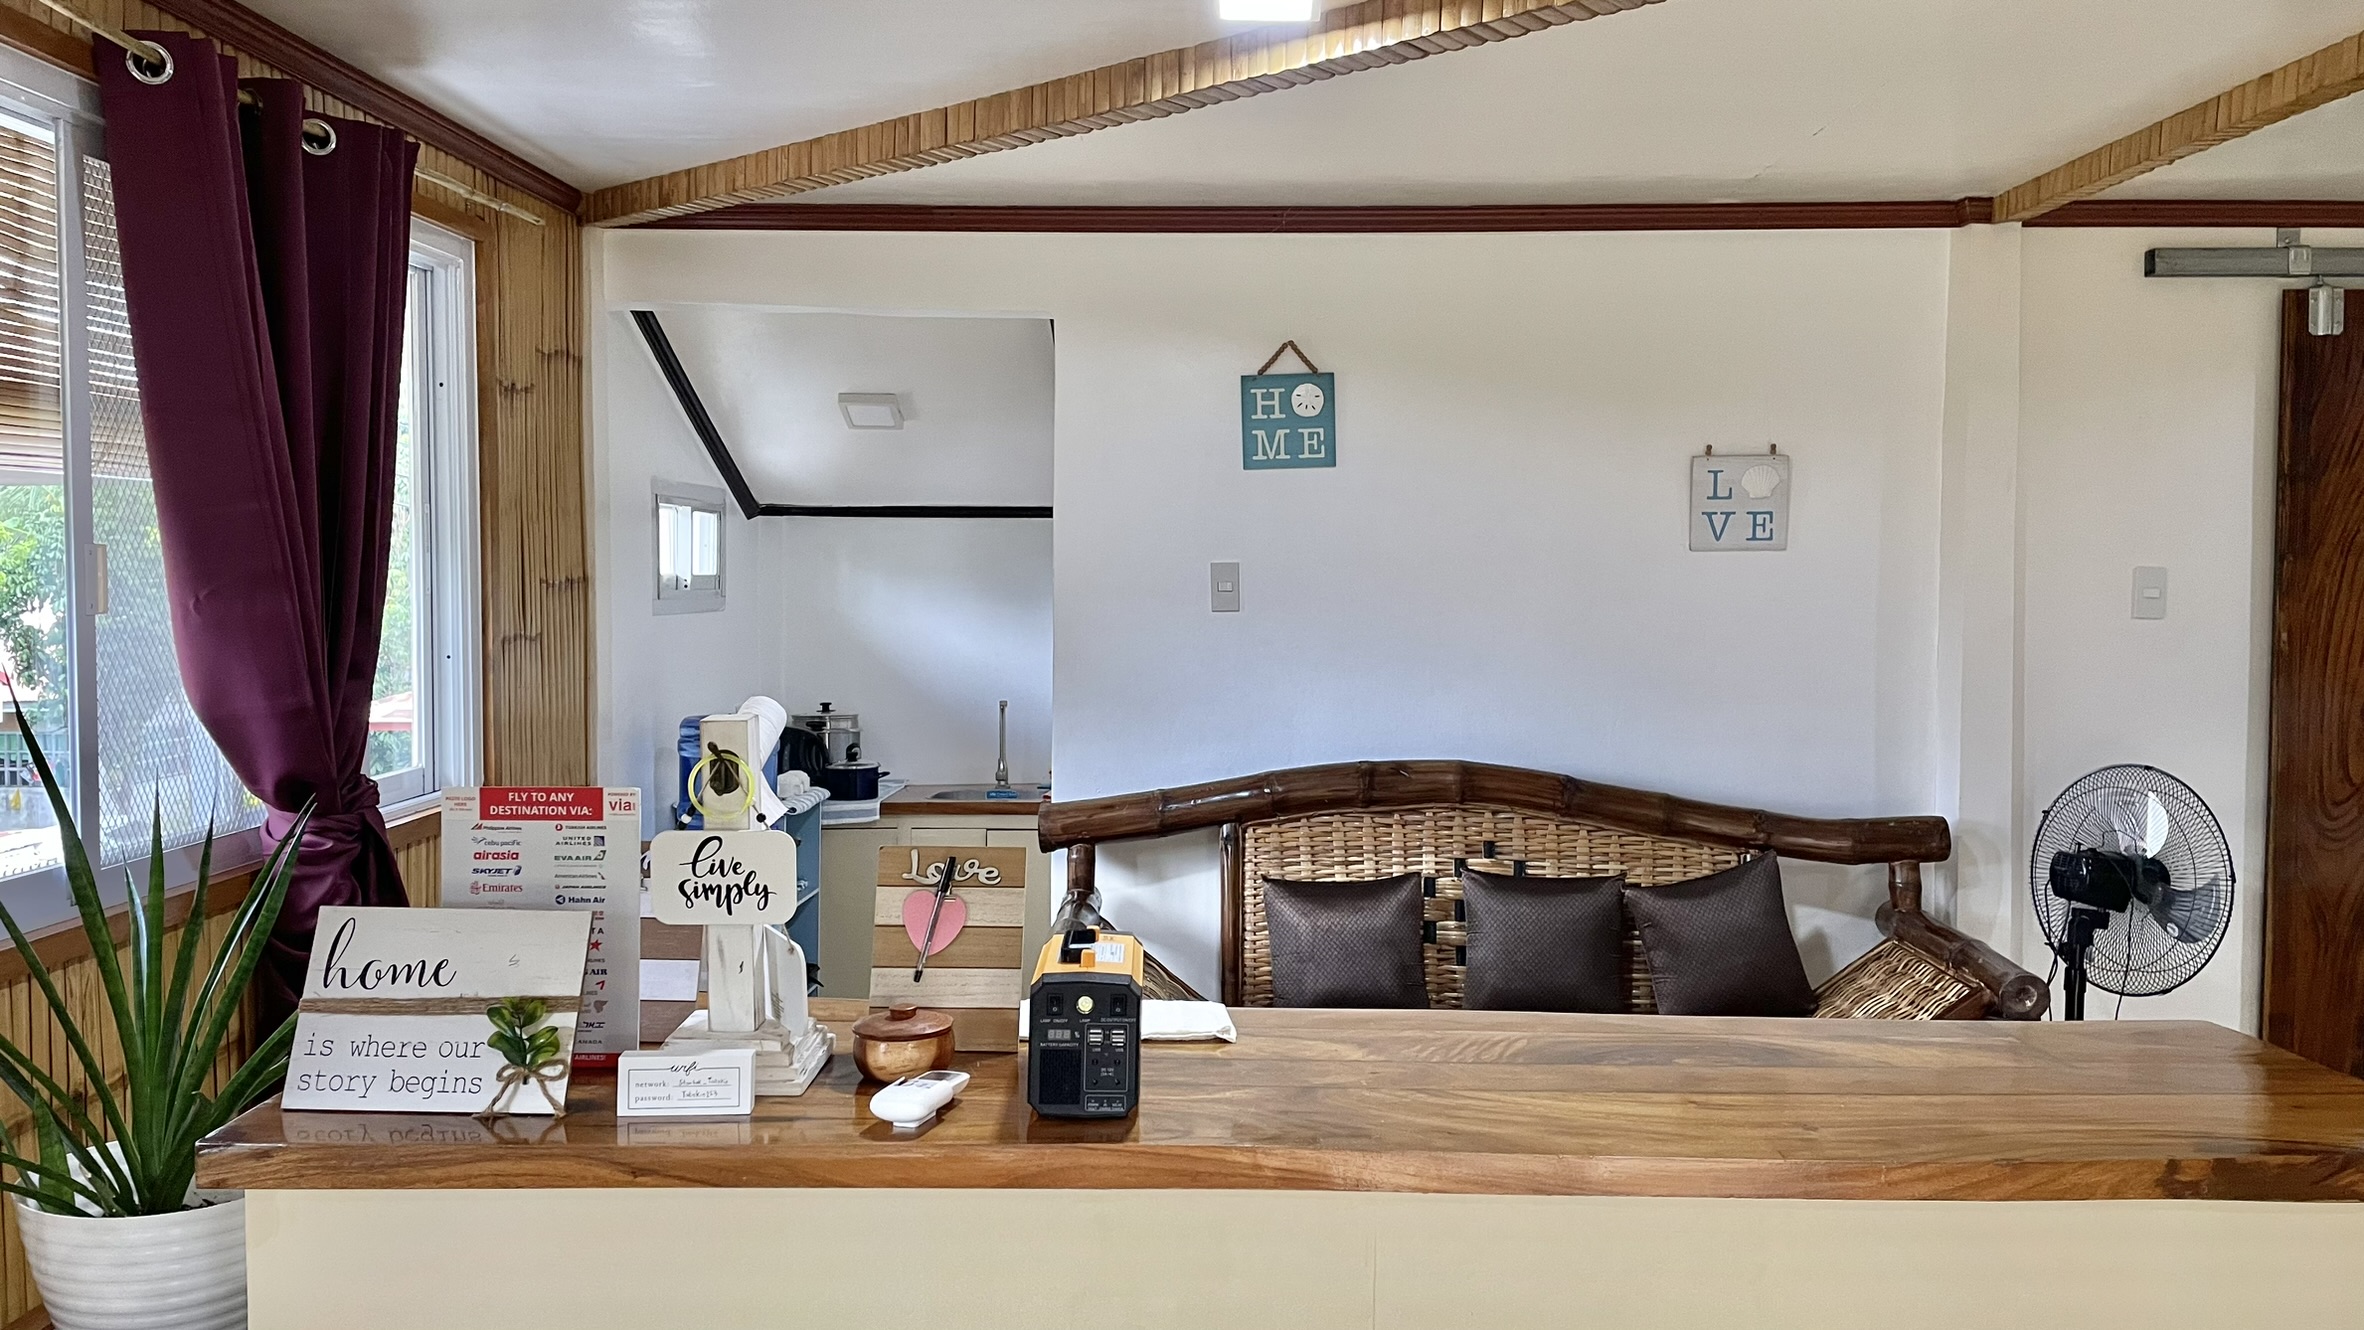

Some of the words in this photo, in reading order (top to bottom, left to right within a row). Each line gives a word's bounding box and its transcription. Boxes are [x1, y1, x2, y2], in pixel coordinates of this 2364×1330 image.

[509, 792, 528, 802] FLY
[530, 792, 547, 802] TO
[549, 792, 575, 803] ANY
[489, 805, 567, 816] DESTINATION
[569, 806, 593, 816] VIA:
[500, 839, 522, 847] pacific
[473, 850, 519, 860] airasia
[679, 836, 745, 878] live
[471, 867, 513, 875] SKYJET
[902, 849, 1002, 885] Love
[482, 883, 523, 893] Emirates
[678, 870, 777, 916] simply
[323, 917, 457, 990] home
[303, 1032, 334, 1056] is
[350, 1034, 427, 1058] where
[438, 1041, 486, 1058] our
[297, 1069, 377, 1098] story
[388, 1069, 482, 1100] begins
[634, 1080, 670, 1088] network:
[634, 1094, 673, 1104] password:
